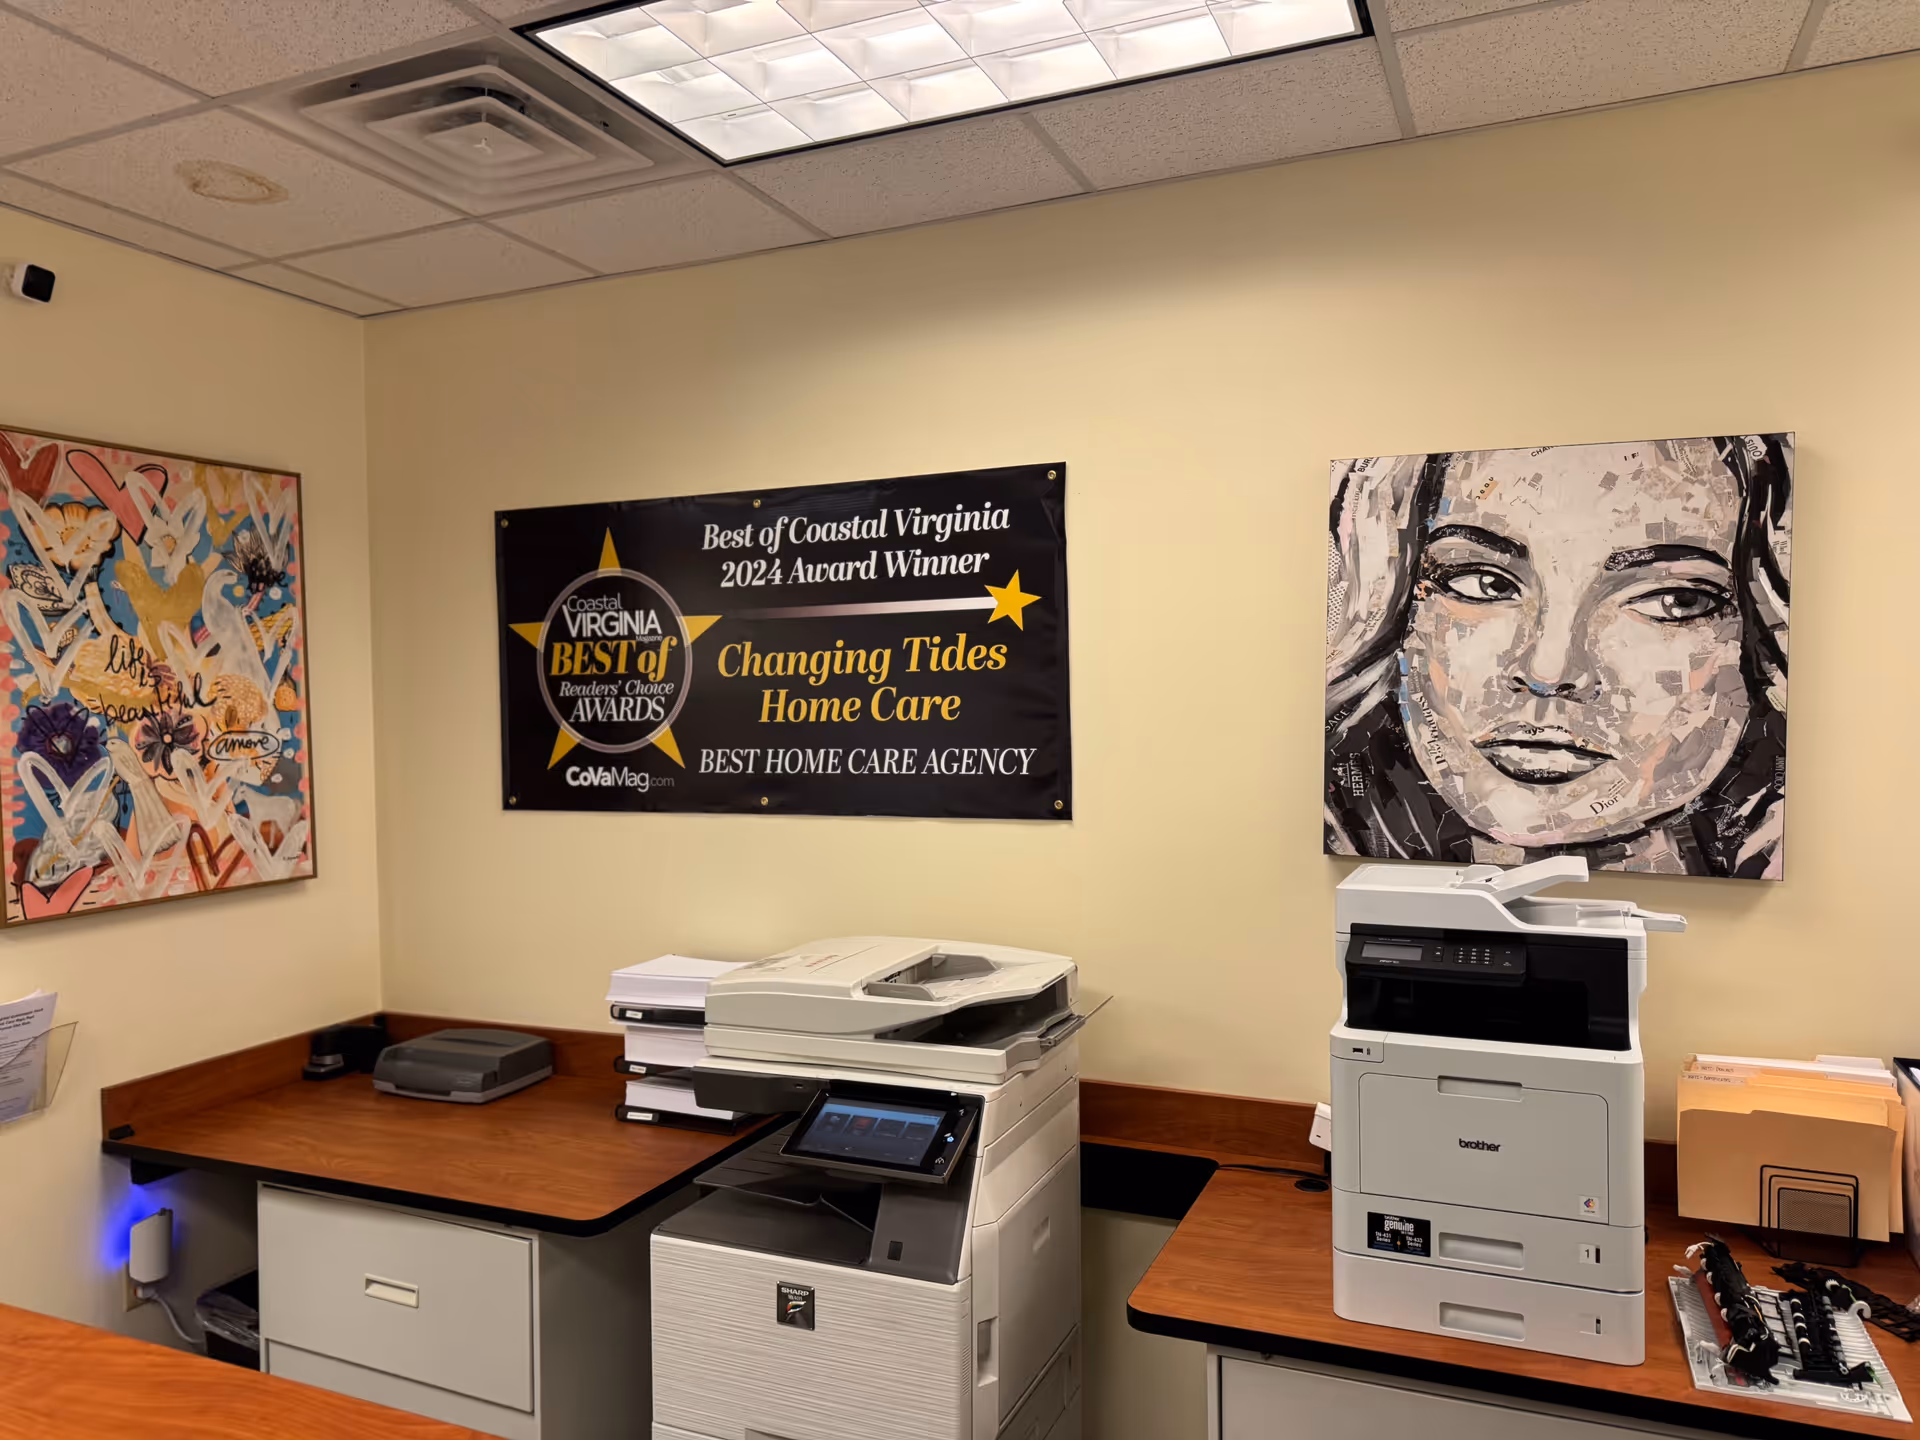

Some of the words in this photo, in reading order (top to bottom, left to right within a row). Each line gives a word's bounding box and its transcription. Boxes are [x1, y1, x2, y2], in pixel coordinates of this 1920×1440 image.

[702, 523, 754, 550] Best
[758, 516, 788, 554] of
[789, 508, 888, 544] Coastal
[894, 501, 1011, 543] Virginia
[720, 558, 783, 588] 2024
[787, 550, 878, 585] Award
[884, 549, 990, 578] Winner
[567, 592, 623, 612] Coastal
[562, 604, 662, 638] VIRGINIA
[104, 634, 145, 679] life
[551, 640, 636, 675] BEST
[637, 635, 678, 683] of
[717, 639, 892, 686] Changing
[902, 633, 1008, 672] Tides
[99, 672, 218, 725] beautiful
[625, 679, 674, 695] Choice
[568, 695, 666, 722] AWARDS
[758, 689, 861, 723] Home
[870, 686, 961, 721] Care
[215, 736, 270, 755] amore
[699, 748, 760, 774] BEST
[764, 748, 843, 774] HOME
[848, 748, 918, 774] CARE
[920, 748, 1037, 775] AGENCY
[565, 765, 675, 792] CoVaMag.com
[1589, 795, 1619, 815] Dior
[1458, 1138, 1501, 1152] brother
[1384, 1219, 1414, 1231] genuine
[1585, 1249, 1589, 1259] 1
[781, 1287, 809, 1296] SHARP
